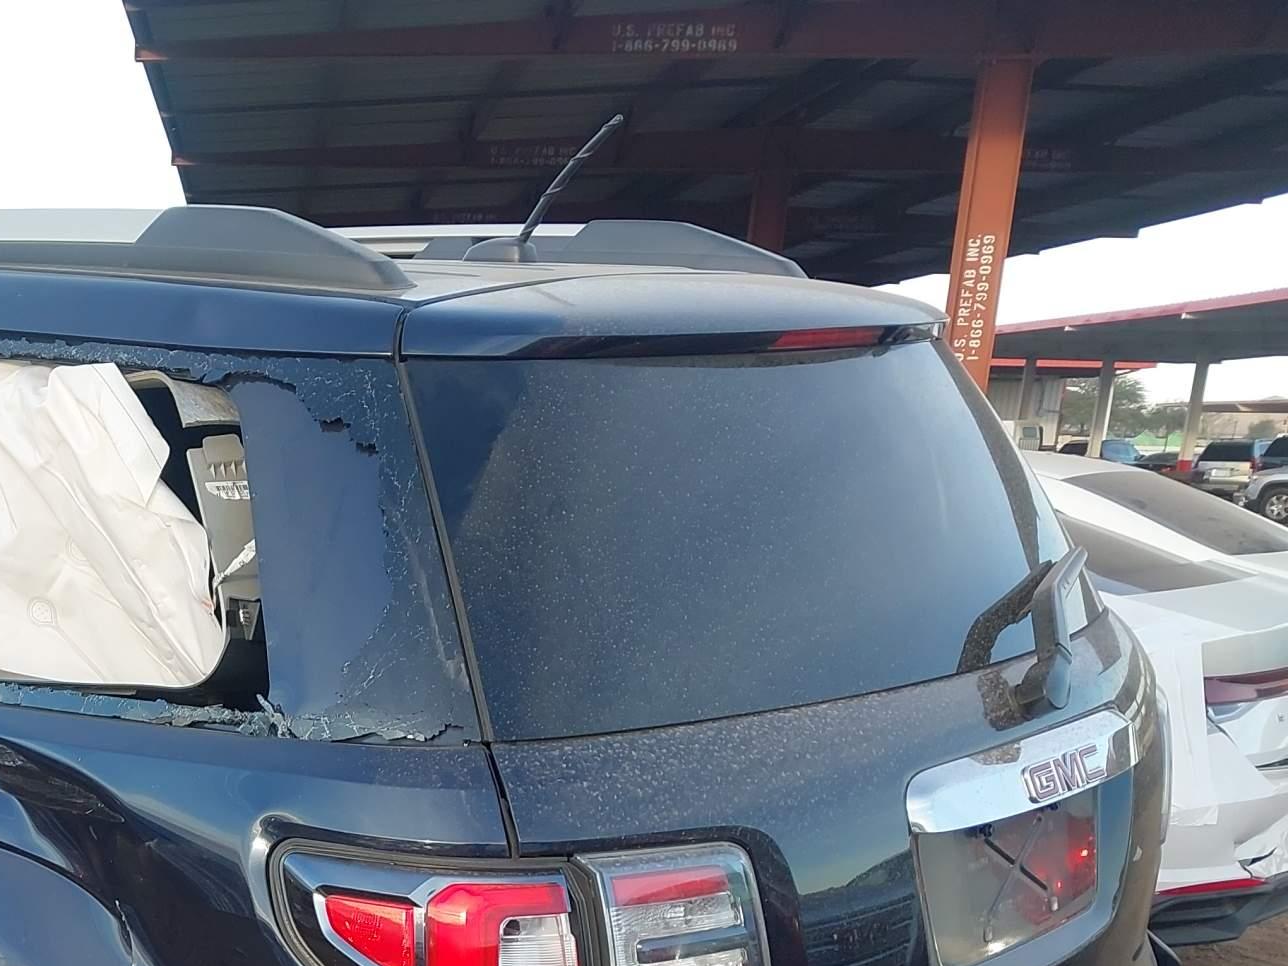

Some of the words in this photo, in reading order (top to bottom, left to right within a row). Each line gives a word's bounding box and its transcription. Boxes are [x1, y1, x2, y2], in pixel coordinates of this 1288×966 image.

[965, 233, 982, 262] INC.
[956, 269, 977, 326] PREFAB
[966, 234, 996, 361] 1-866-799-0969
[1024, 743, 1108, 802] GMC
